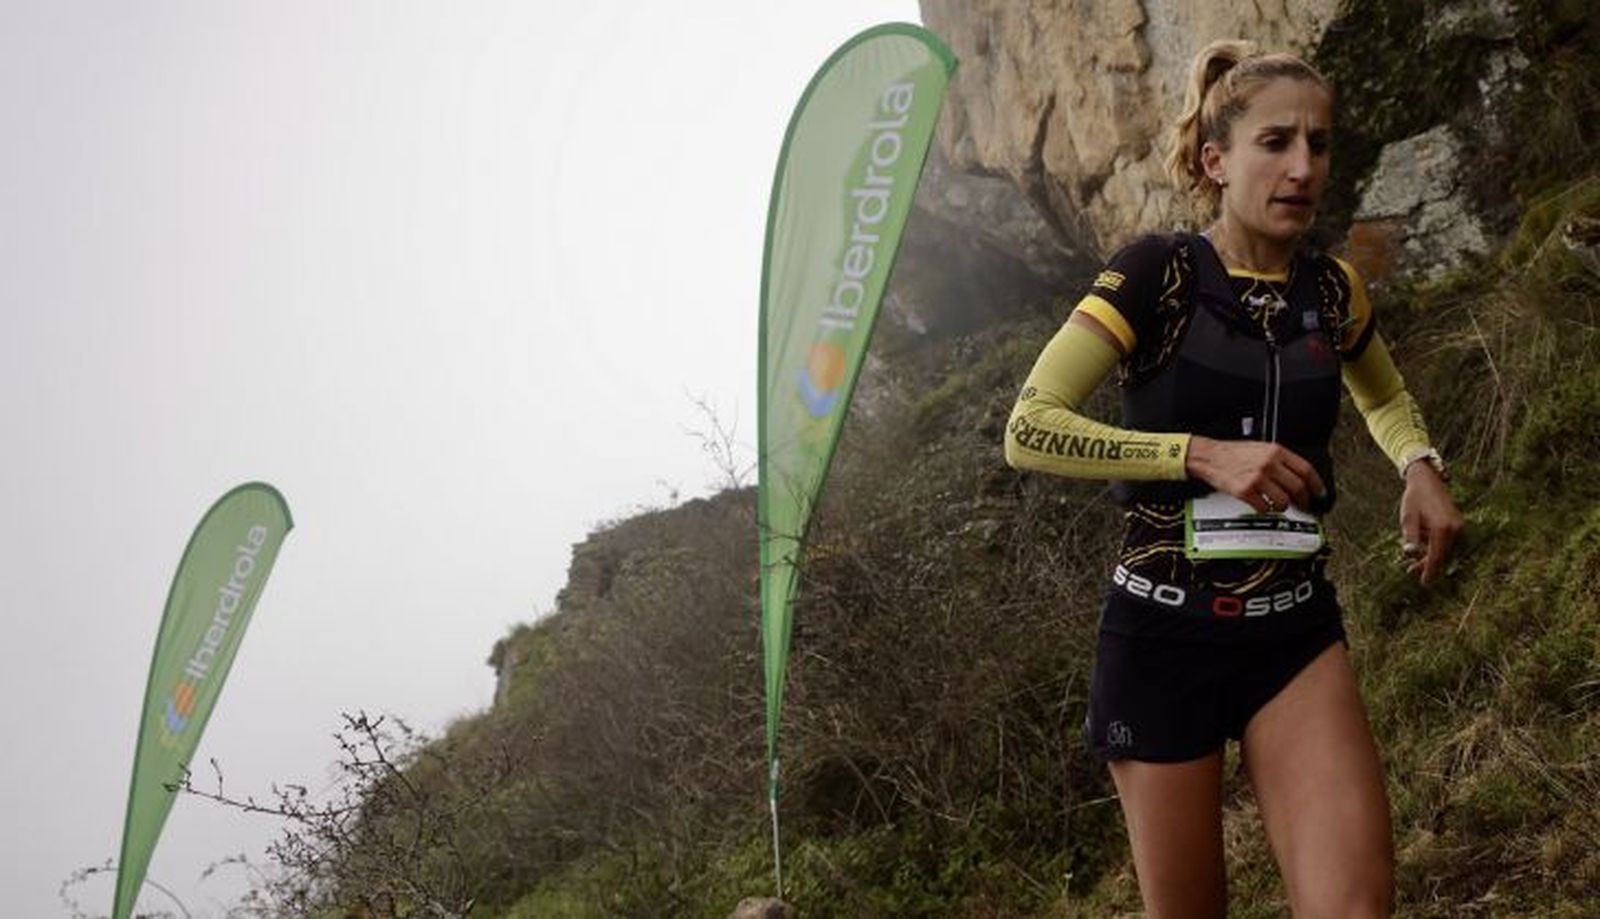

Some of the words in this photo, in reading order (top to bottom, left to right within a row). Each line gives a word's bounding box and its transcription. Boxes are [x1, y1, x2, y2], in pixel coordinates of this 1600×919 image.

[818, 81, 915, 332] Iberdrola
[1009, 416, 1122, 461] RUNNERS
[185, 525, 267, 680] Iberdrola
